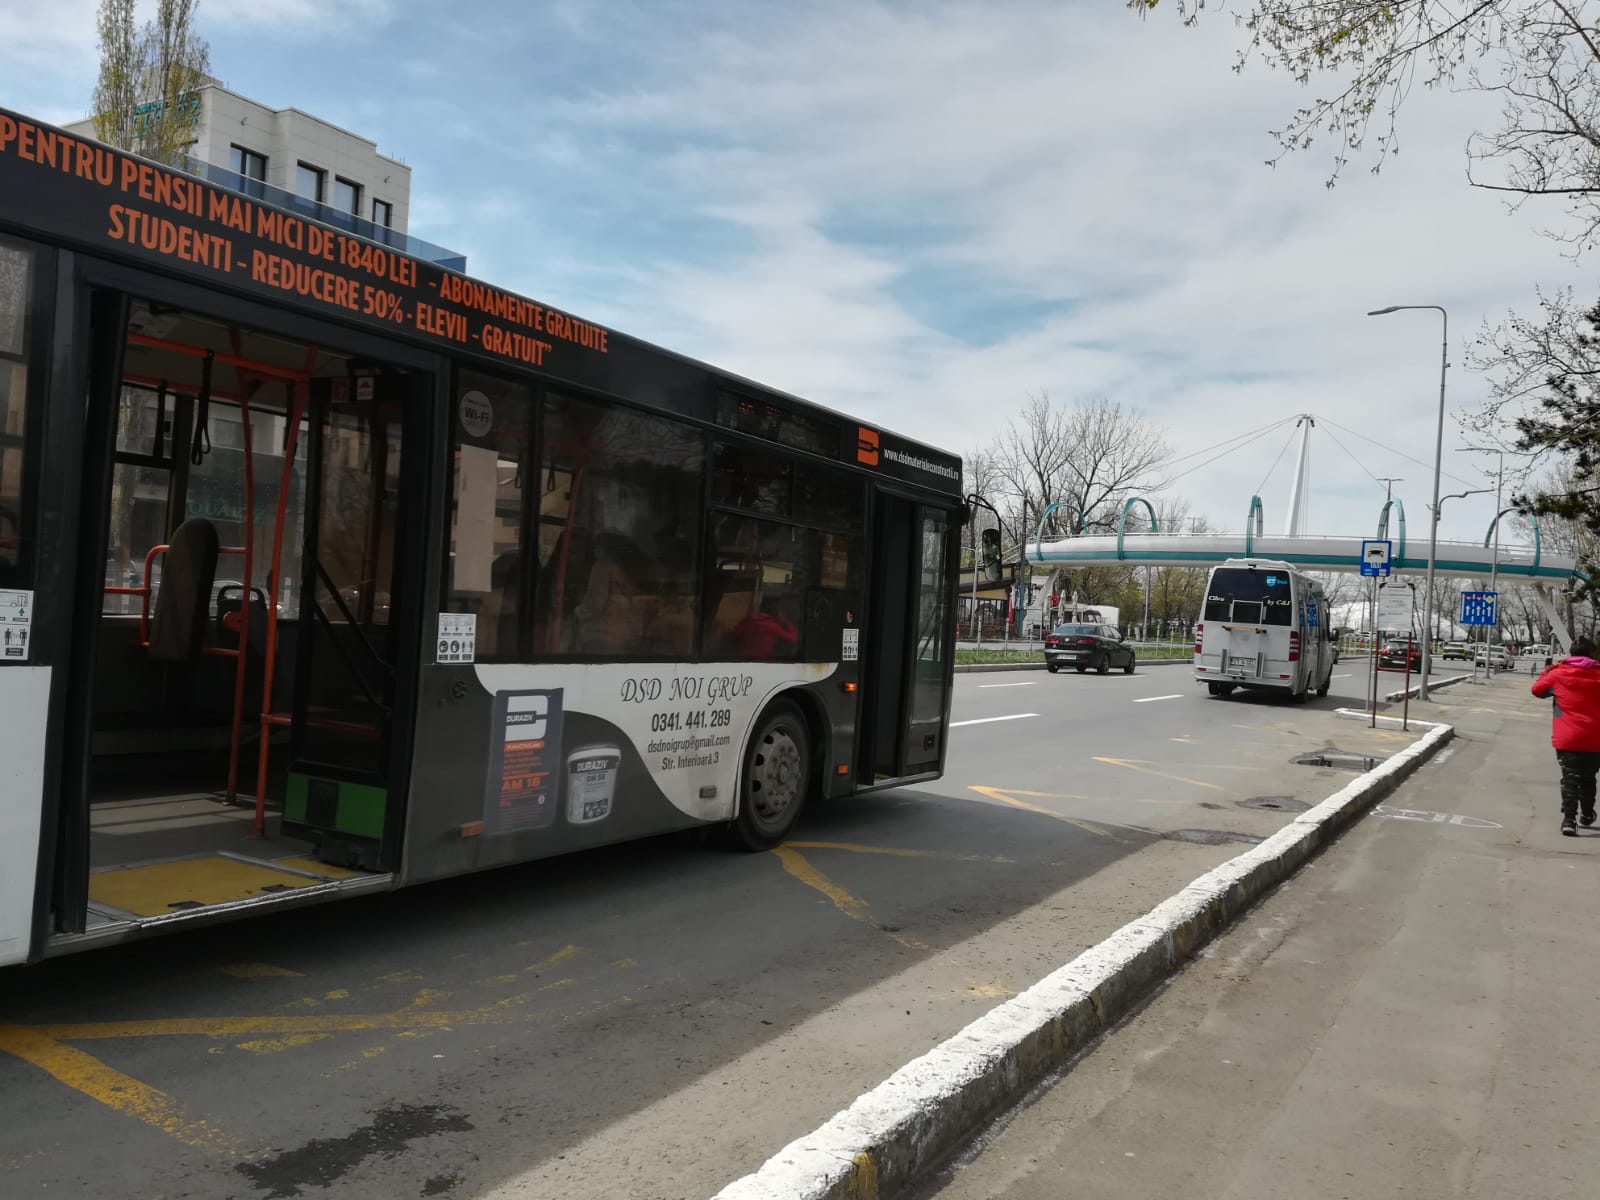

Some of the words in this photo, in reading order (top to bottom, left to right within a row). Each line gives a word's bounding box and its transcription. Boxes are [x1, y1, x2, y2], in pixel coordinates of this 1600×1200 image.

[0, 114, 114, 186] PENTRU
[121, 157, 203, 217] PENSII
[208, 190, 252, 233] MAI
[257, 208, 303, 250] MICI
[308, 225, 335, 261] DE
[337, 236, 387, 277] 1840
[388, 254, 417, 289] LEI
[439, 273, 543, 332] ABONAMENTE
[544, 311, 608, 353] GRATUITE
[107, 204, 232, 273] STUDENTI
[252, 250, 360, 311] REDUCERE
[363, 285, 404, 324] 50%
[415, 303, 468, 343] ELEVII
[620, 677, 662, 703] DSD
[669, 676, 704, 701] NOI
[707, 672, 753, 706] GRUP
[651, 713, 682, 732] 0341.
[685, 711, 707, 730] 441.
[711, 709, 731, 727] 289
[647, 735, 731, 753] dsdnoigrup@gmail.com
[576, 760, 609, 772] DURAZIV
[662, 757, 676, 770] Str.
[713, 752, 720, 764] 3
